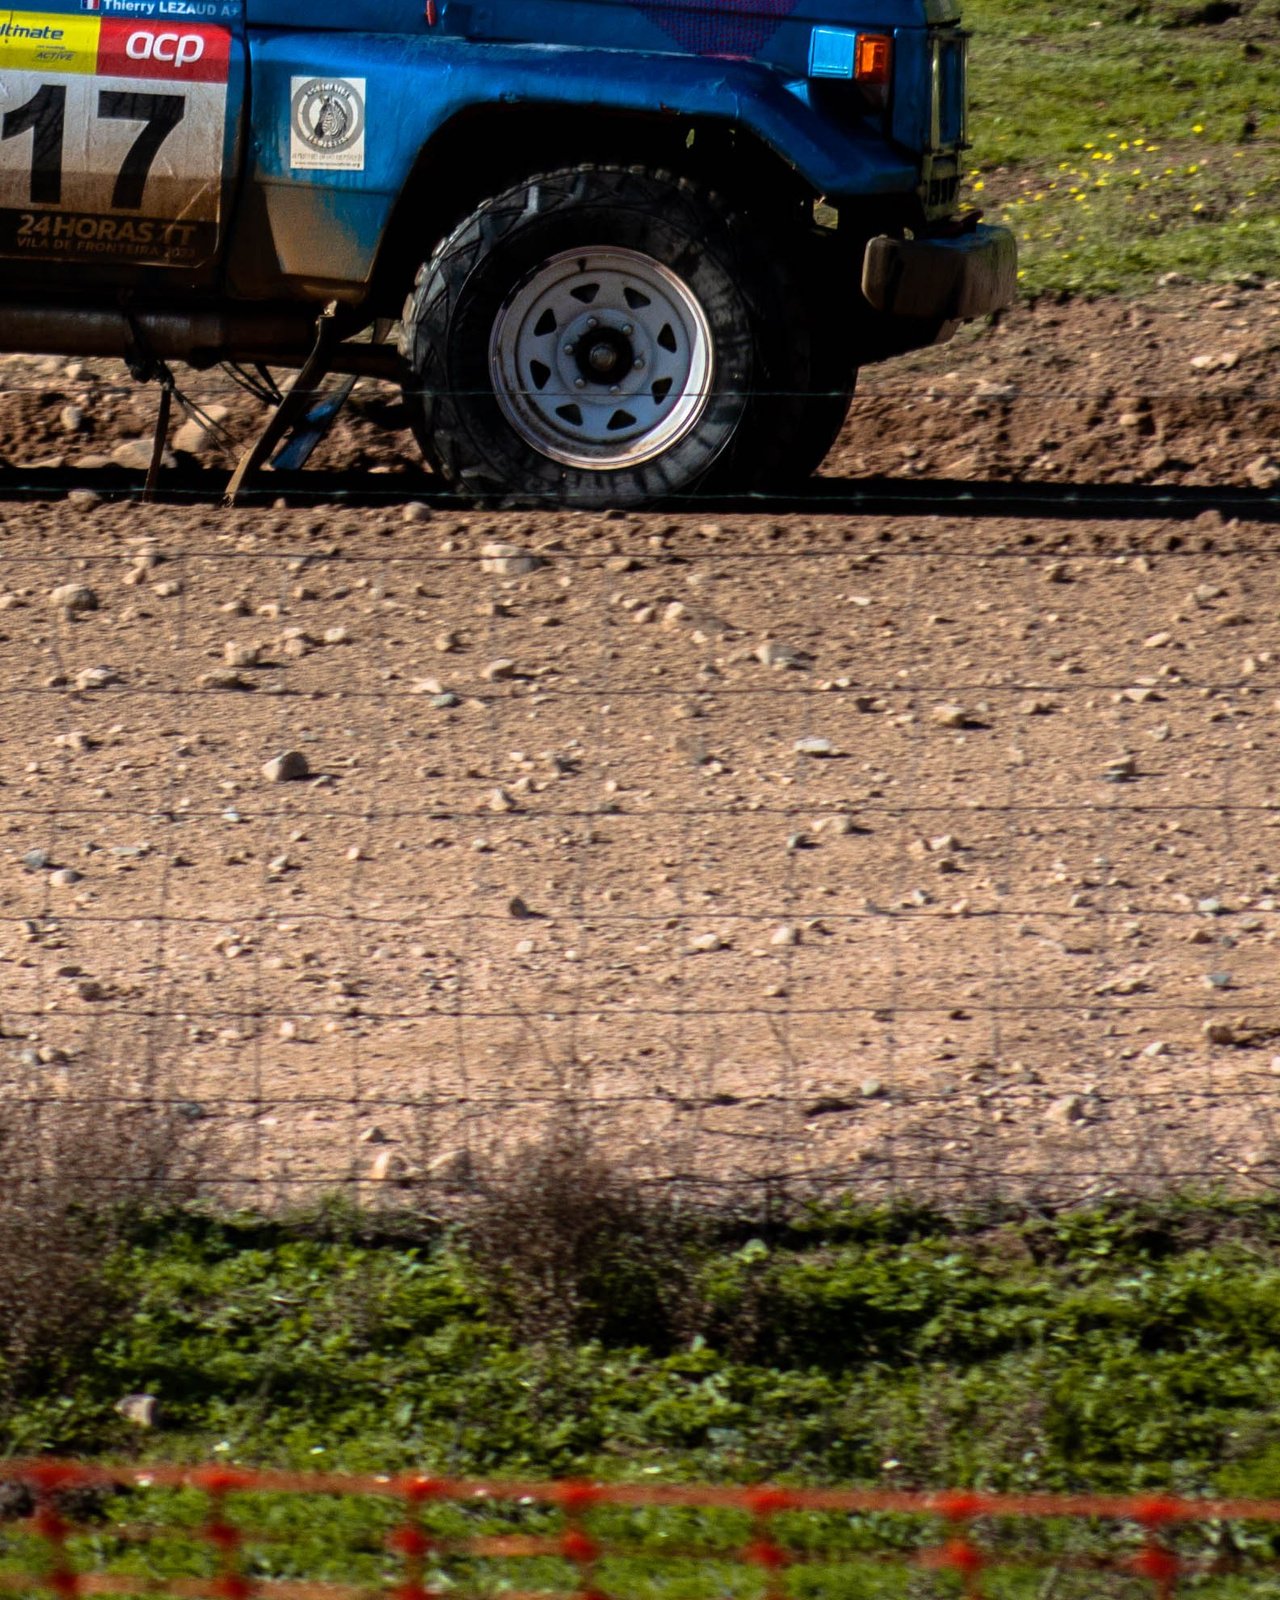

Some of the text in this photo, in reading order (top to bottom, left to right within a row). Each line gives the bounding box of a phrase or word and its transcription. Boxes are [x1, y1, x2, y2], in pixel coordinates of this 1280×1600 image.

[159, 1, 217, 16] LEZAUD
[221, 5, 240, 16] A+
[36, 52, 75, 62] ACTIVE
[126, 31, 204, 68] acp
[1, 84, 185, 210] 17
[158, 223, 197, 247] TT
[17, 237, 49, 248] VILA
[53, 240, 72, 250] DE
[76, 241, 160, 256] FRONTEIRA
